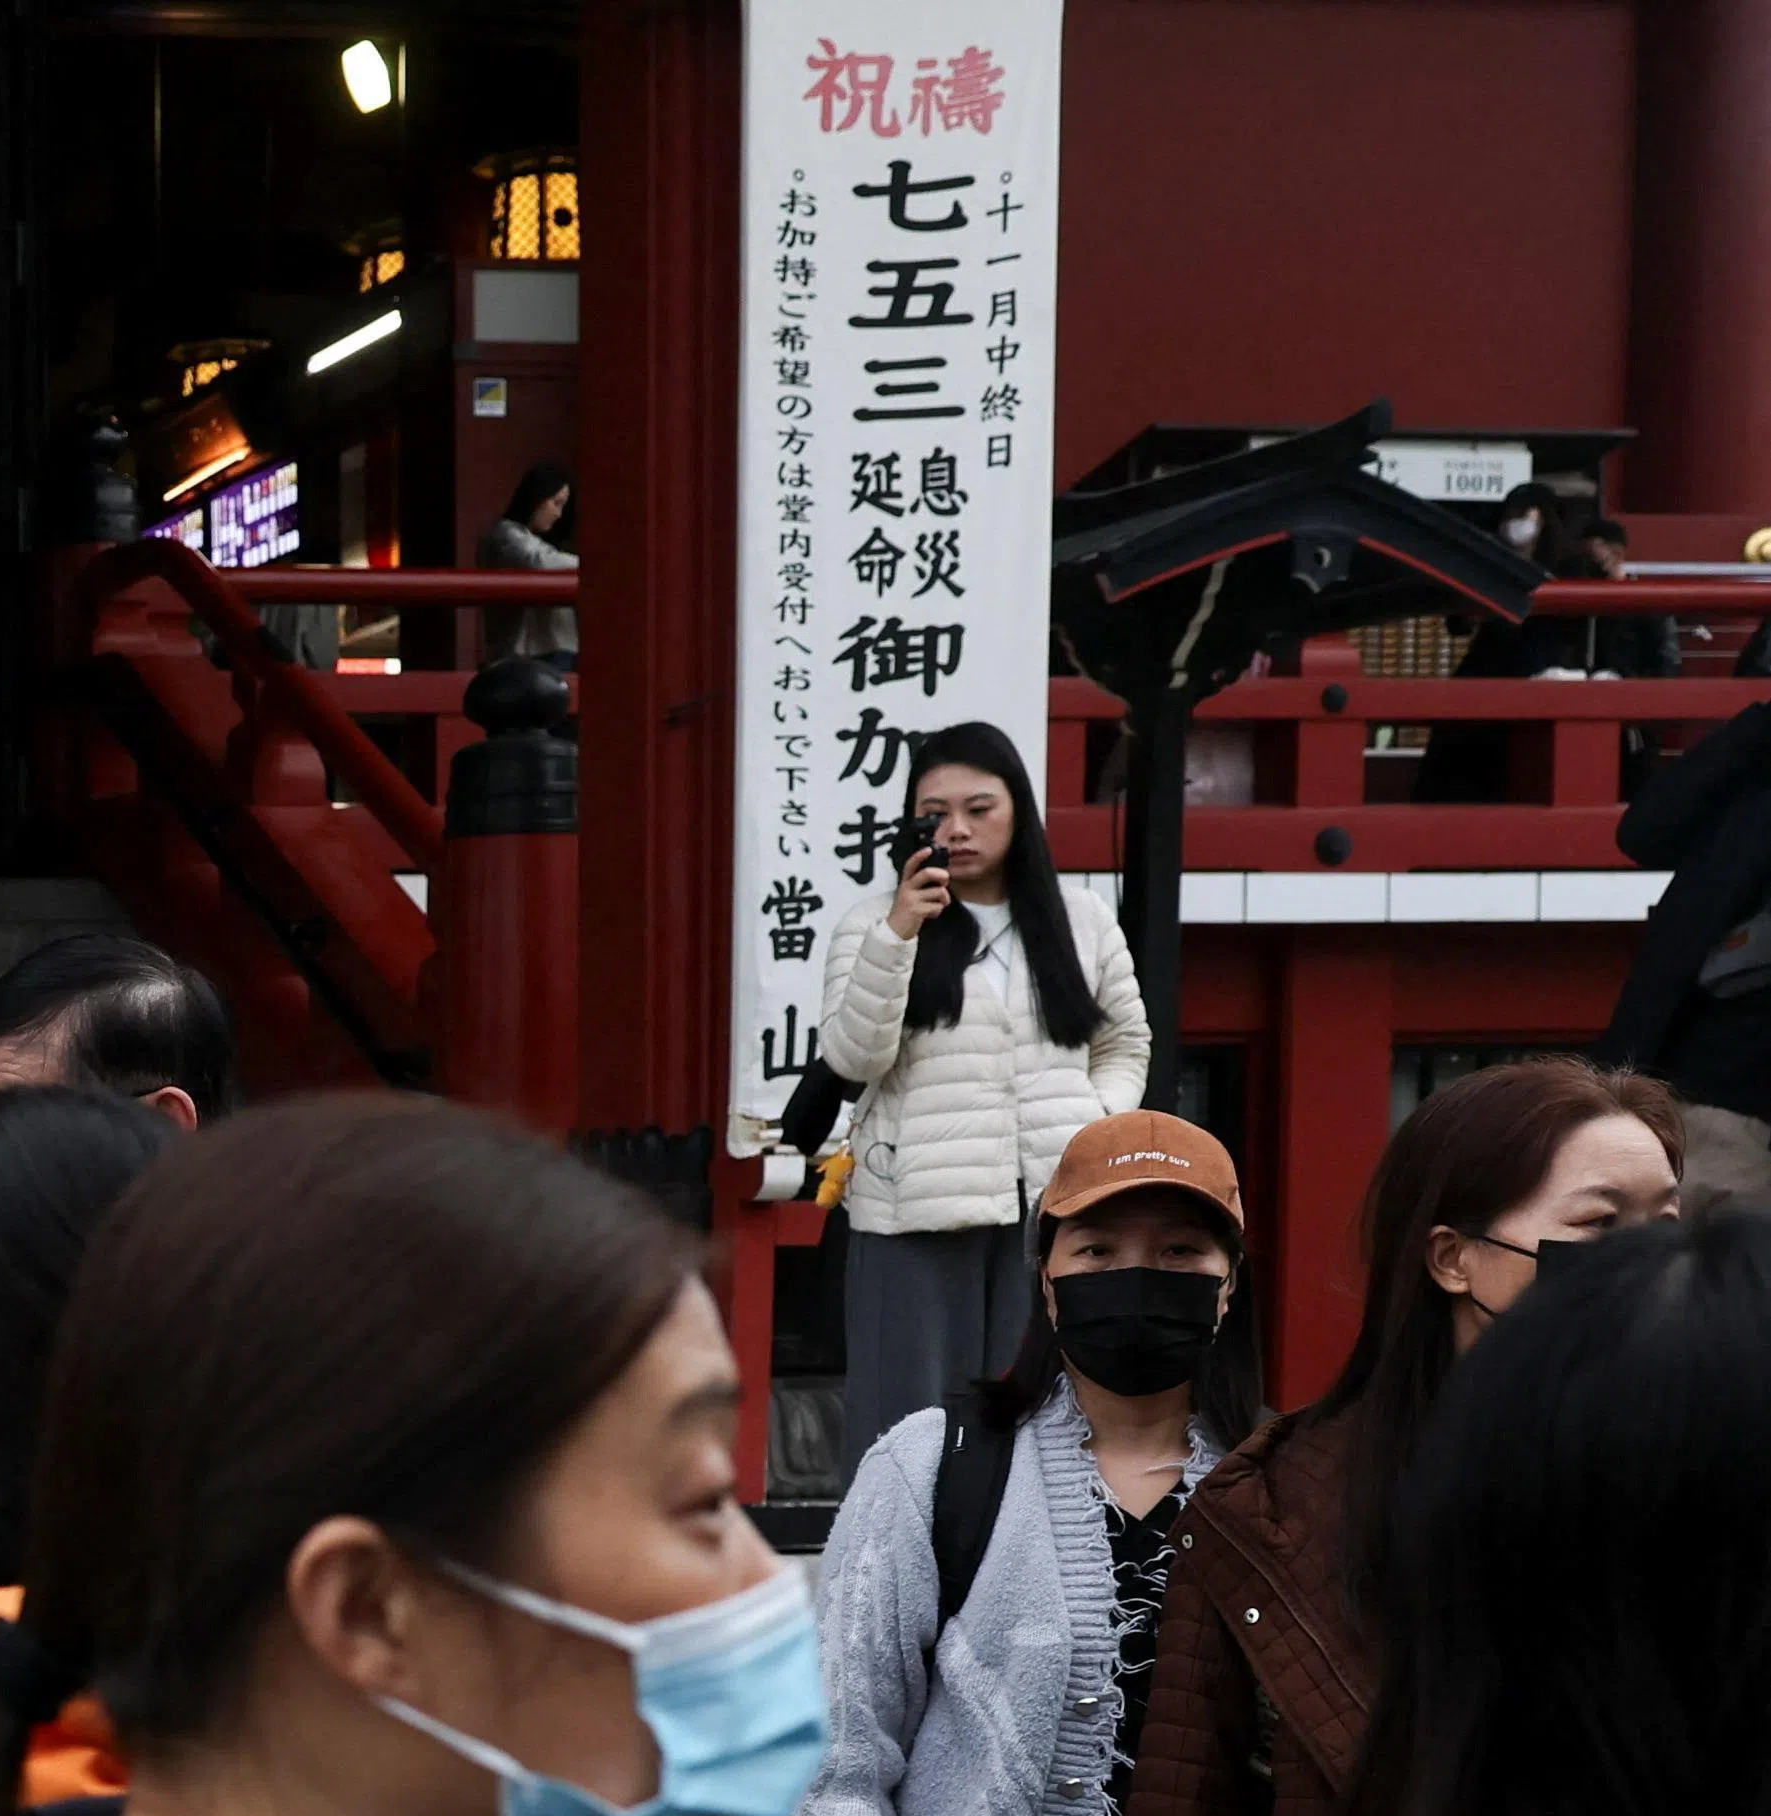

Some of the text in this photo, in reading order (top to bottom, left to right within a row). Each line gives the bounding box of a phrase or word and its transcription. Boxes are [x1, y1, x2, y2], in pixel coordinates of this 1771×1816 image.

[847, 159, 976, 422] 七五三
[981, 192, 1024, 468] 十一月中終日
[847, 451, 907, 598] 延命
[909, 446, 969, 598] 息災
[1115, 1154, 1132, 1165] am
[1134, 1151, 1167, 1162] pretty
[1168, 1155, 1190, 1168] sure
